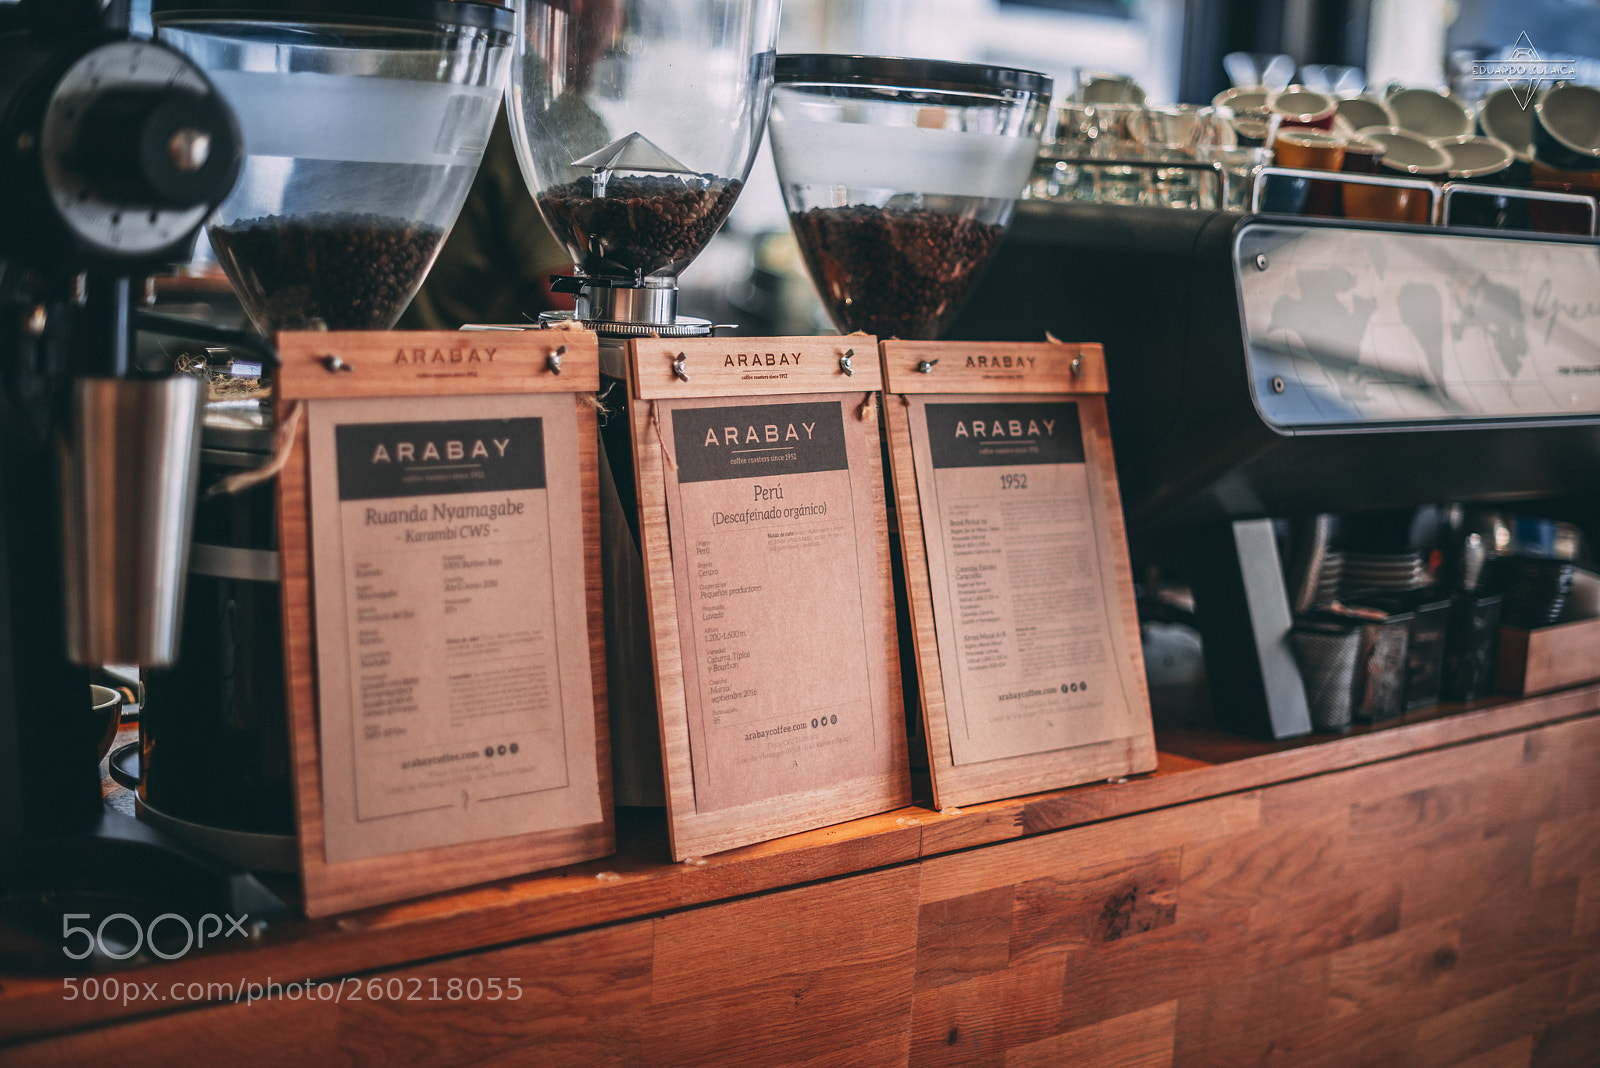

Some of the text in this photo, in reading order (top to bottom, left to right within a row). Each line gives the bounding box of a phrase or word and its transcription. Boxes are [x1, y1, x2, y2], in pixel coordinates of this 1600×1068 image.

[395, 348, 497, 364] ARABAY
[724, 352, 802, 367] ARABAY
[965, 355, 1036, 368] ARABAY
[704, 422, 816, 447] ARABAY
[954, 419, 1057, 438] ARABAY
[371, 437, 512, 465] ARABAY
[730, 452, 797, 465] coffee roasters since 1952
[1000, 474, 1028, 490] 1952
[753, 482, 784, 502] Perú
[364, 497, 525, 527] Ruanda Nyamagabe
[712, 501, 828, 527] (Descafeinado orgánico)
[404, 525, 458, 544] Karambi
[459, 524, 491, 541] CWS
[698, 568, 719, 578] Centro
[700, 584, 762, 600] Pequeños productores
[702, 611, 724, 622] Lavado
[713, 662, 738, 672] Bourbon
[712, 688, 758, 703] septiembre 2016
[998, 686, 1058, 702] arabaycoffee.com
[744, 721, 808, 741] arabaycoffee.com
